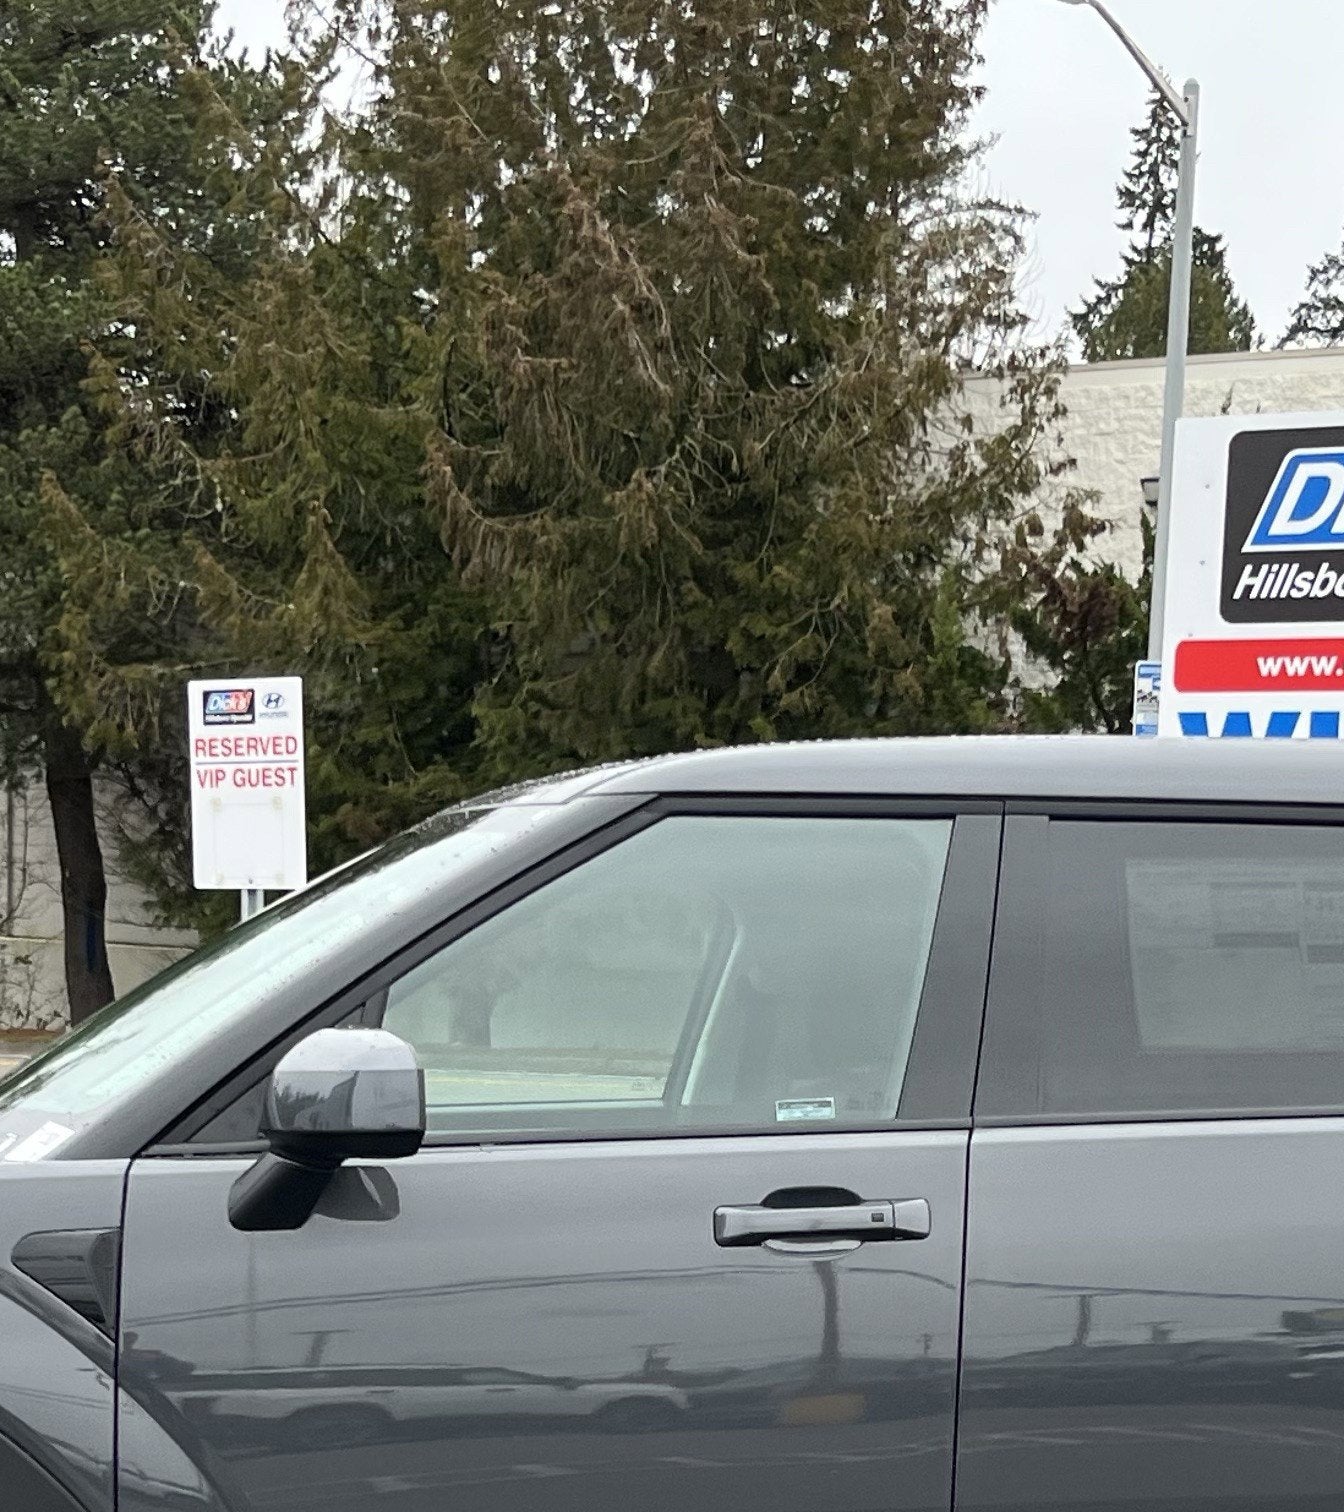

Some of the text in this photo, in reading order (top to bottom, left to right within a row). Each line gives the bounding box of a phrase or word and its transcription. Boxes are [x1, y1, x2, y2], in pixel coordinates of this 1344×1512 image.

[195, 735, 298, 758] RESERVED
[196, 767, 298, 789] VIP GUEST
